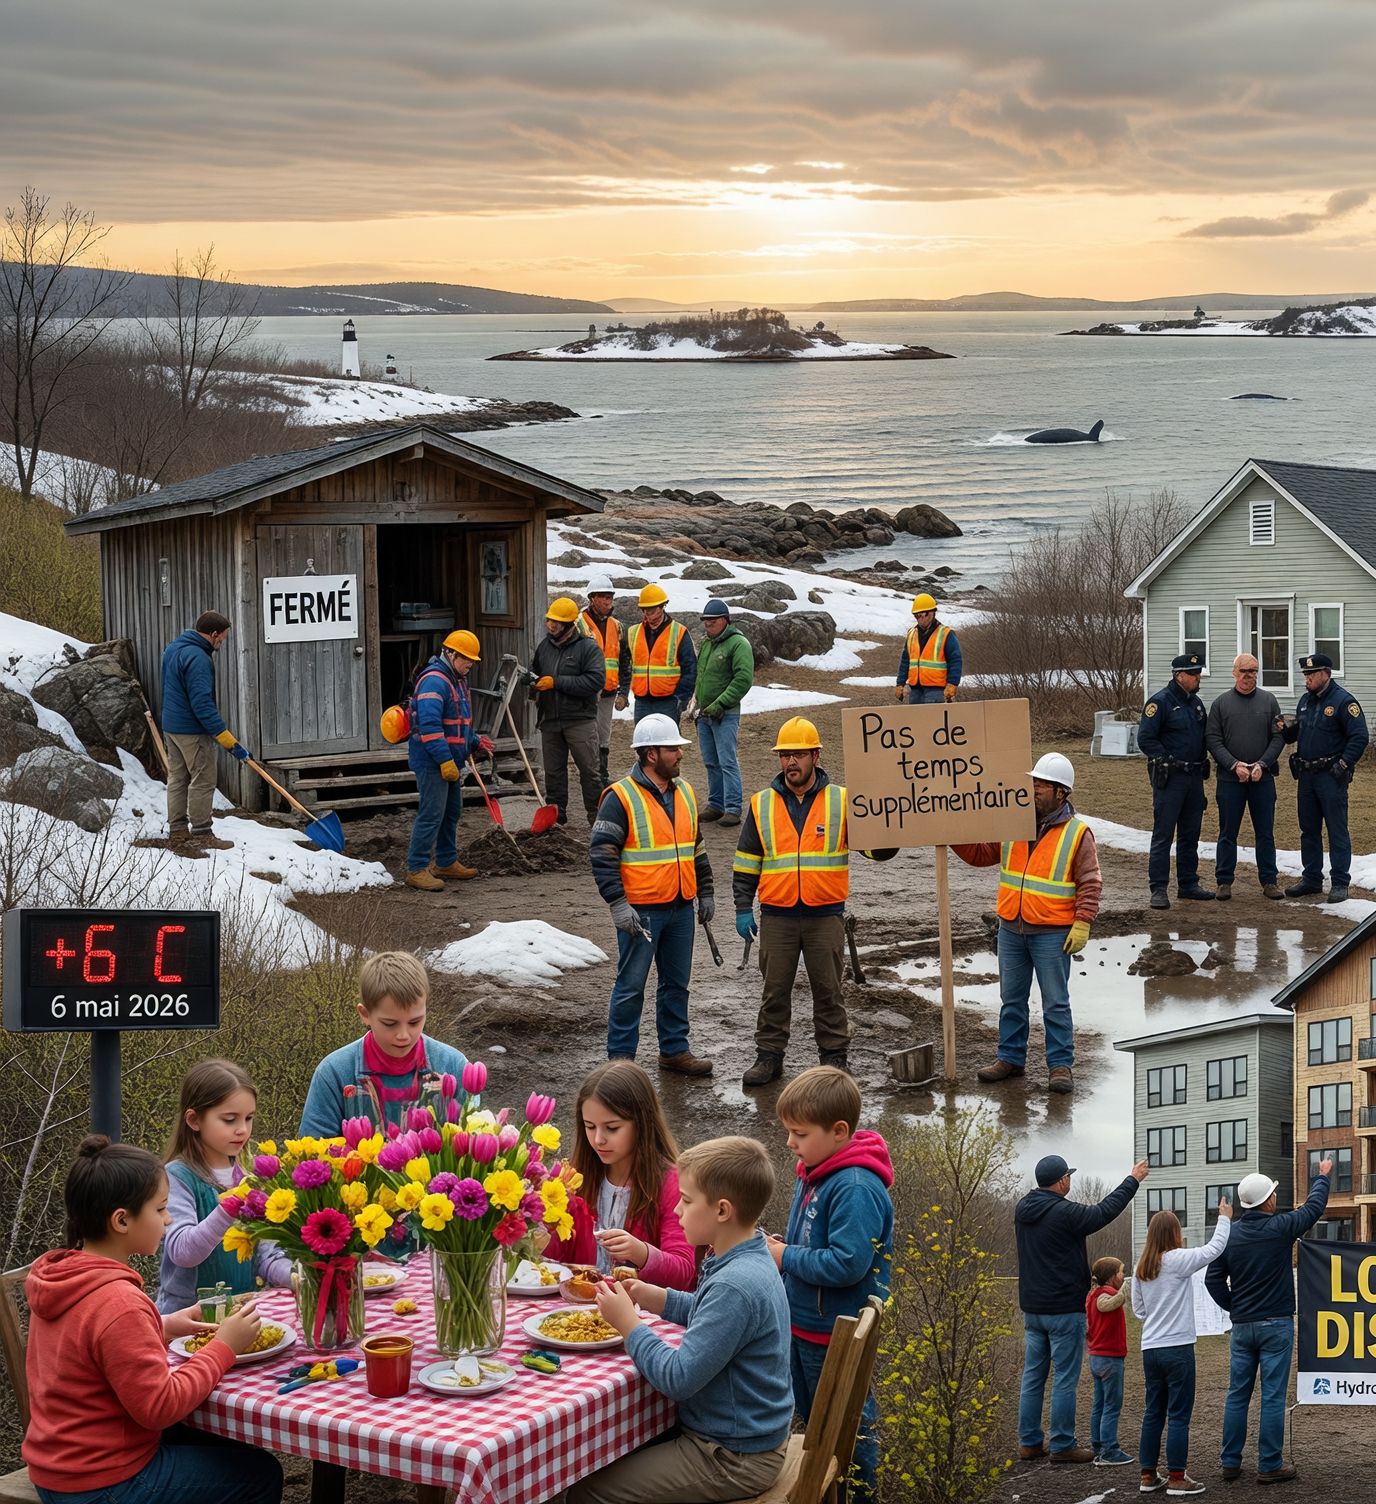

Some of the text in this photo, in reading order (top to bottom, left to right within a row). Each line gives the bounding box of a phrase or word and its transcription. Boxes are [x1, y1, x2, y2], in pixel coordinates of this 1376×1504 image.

[270, 580, 352, 626] FERMÉ
[859, 710, 967, 753] Pas de
[897, 752, 984, 788] temps
[852, 782, 1031, 829] supplémentaire
[46, 924, 186, 983] +6 C
[51, 993, 190, 1019] 6 mai 2026
